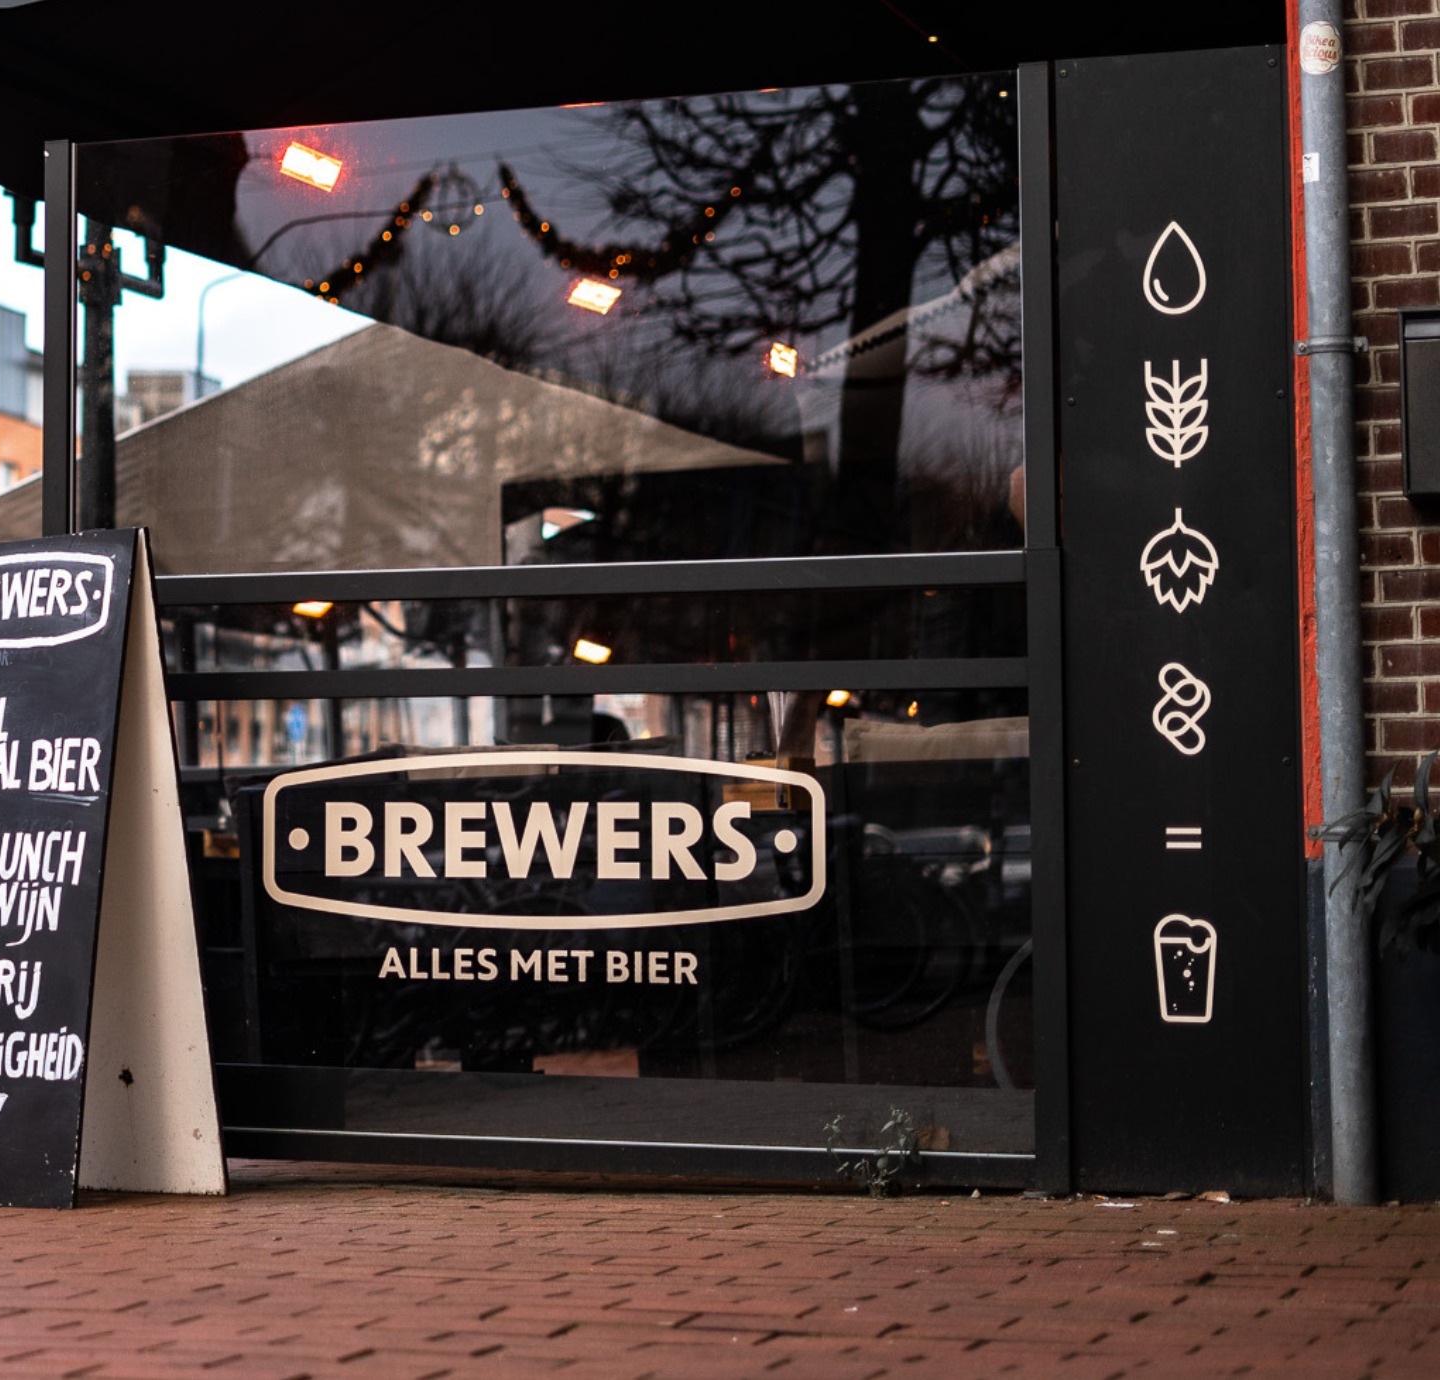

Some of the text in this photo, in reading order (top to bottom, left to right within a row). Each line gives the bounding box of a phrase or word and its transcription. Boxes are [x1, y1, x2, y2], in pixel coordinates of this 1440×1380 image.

[325, 801, 757, 881] BREWERS
[378, 947, 698, 985] ALLES MET BIER
